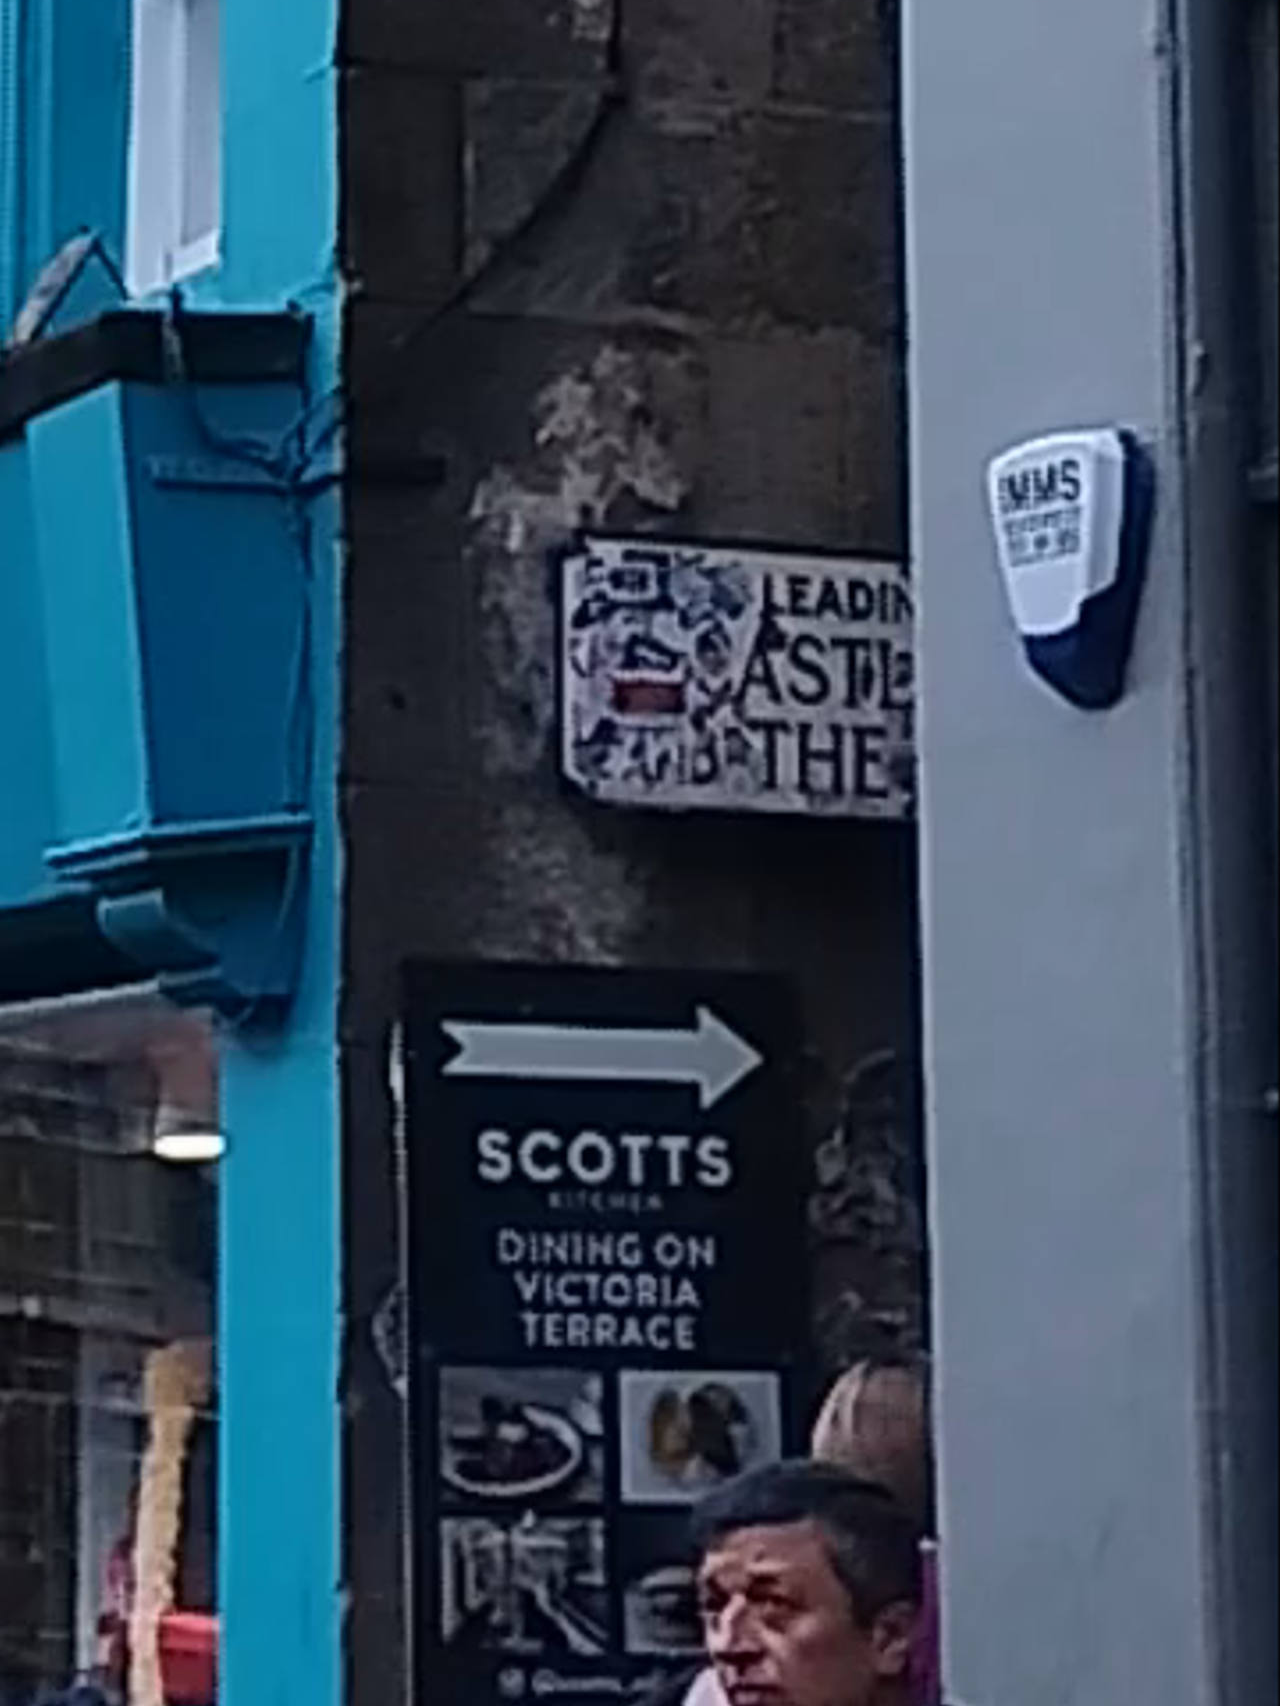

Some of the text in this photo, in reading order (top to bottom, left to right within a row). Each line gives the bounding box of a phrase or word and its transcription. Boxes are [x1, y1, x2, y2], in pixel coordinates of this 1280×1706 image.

[761, 572, 914, 623] LEADIN
[732, 626, 915, 710] ASTL
[477, 1129, 733, 1187] SCOTTS
[497, 1228, 716, 1269] DINING ON
[513, 1270, 701, 1308] VICTORIA
[521, 1311, 697, 1351] TERRACE
